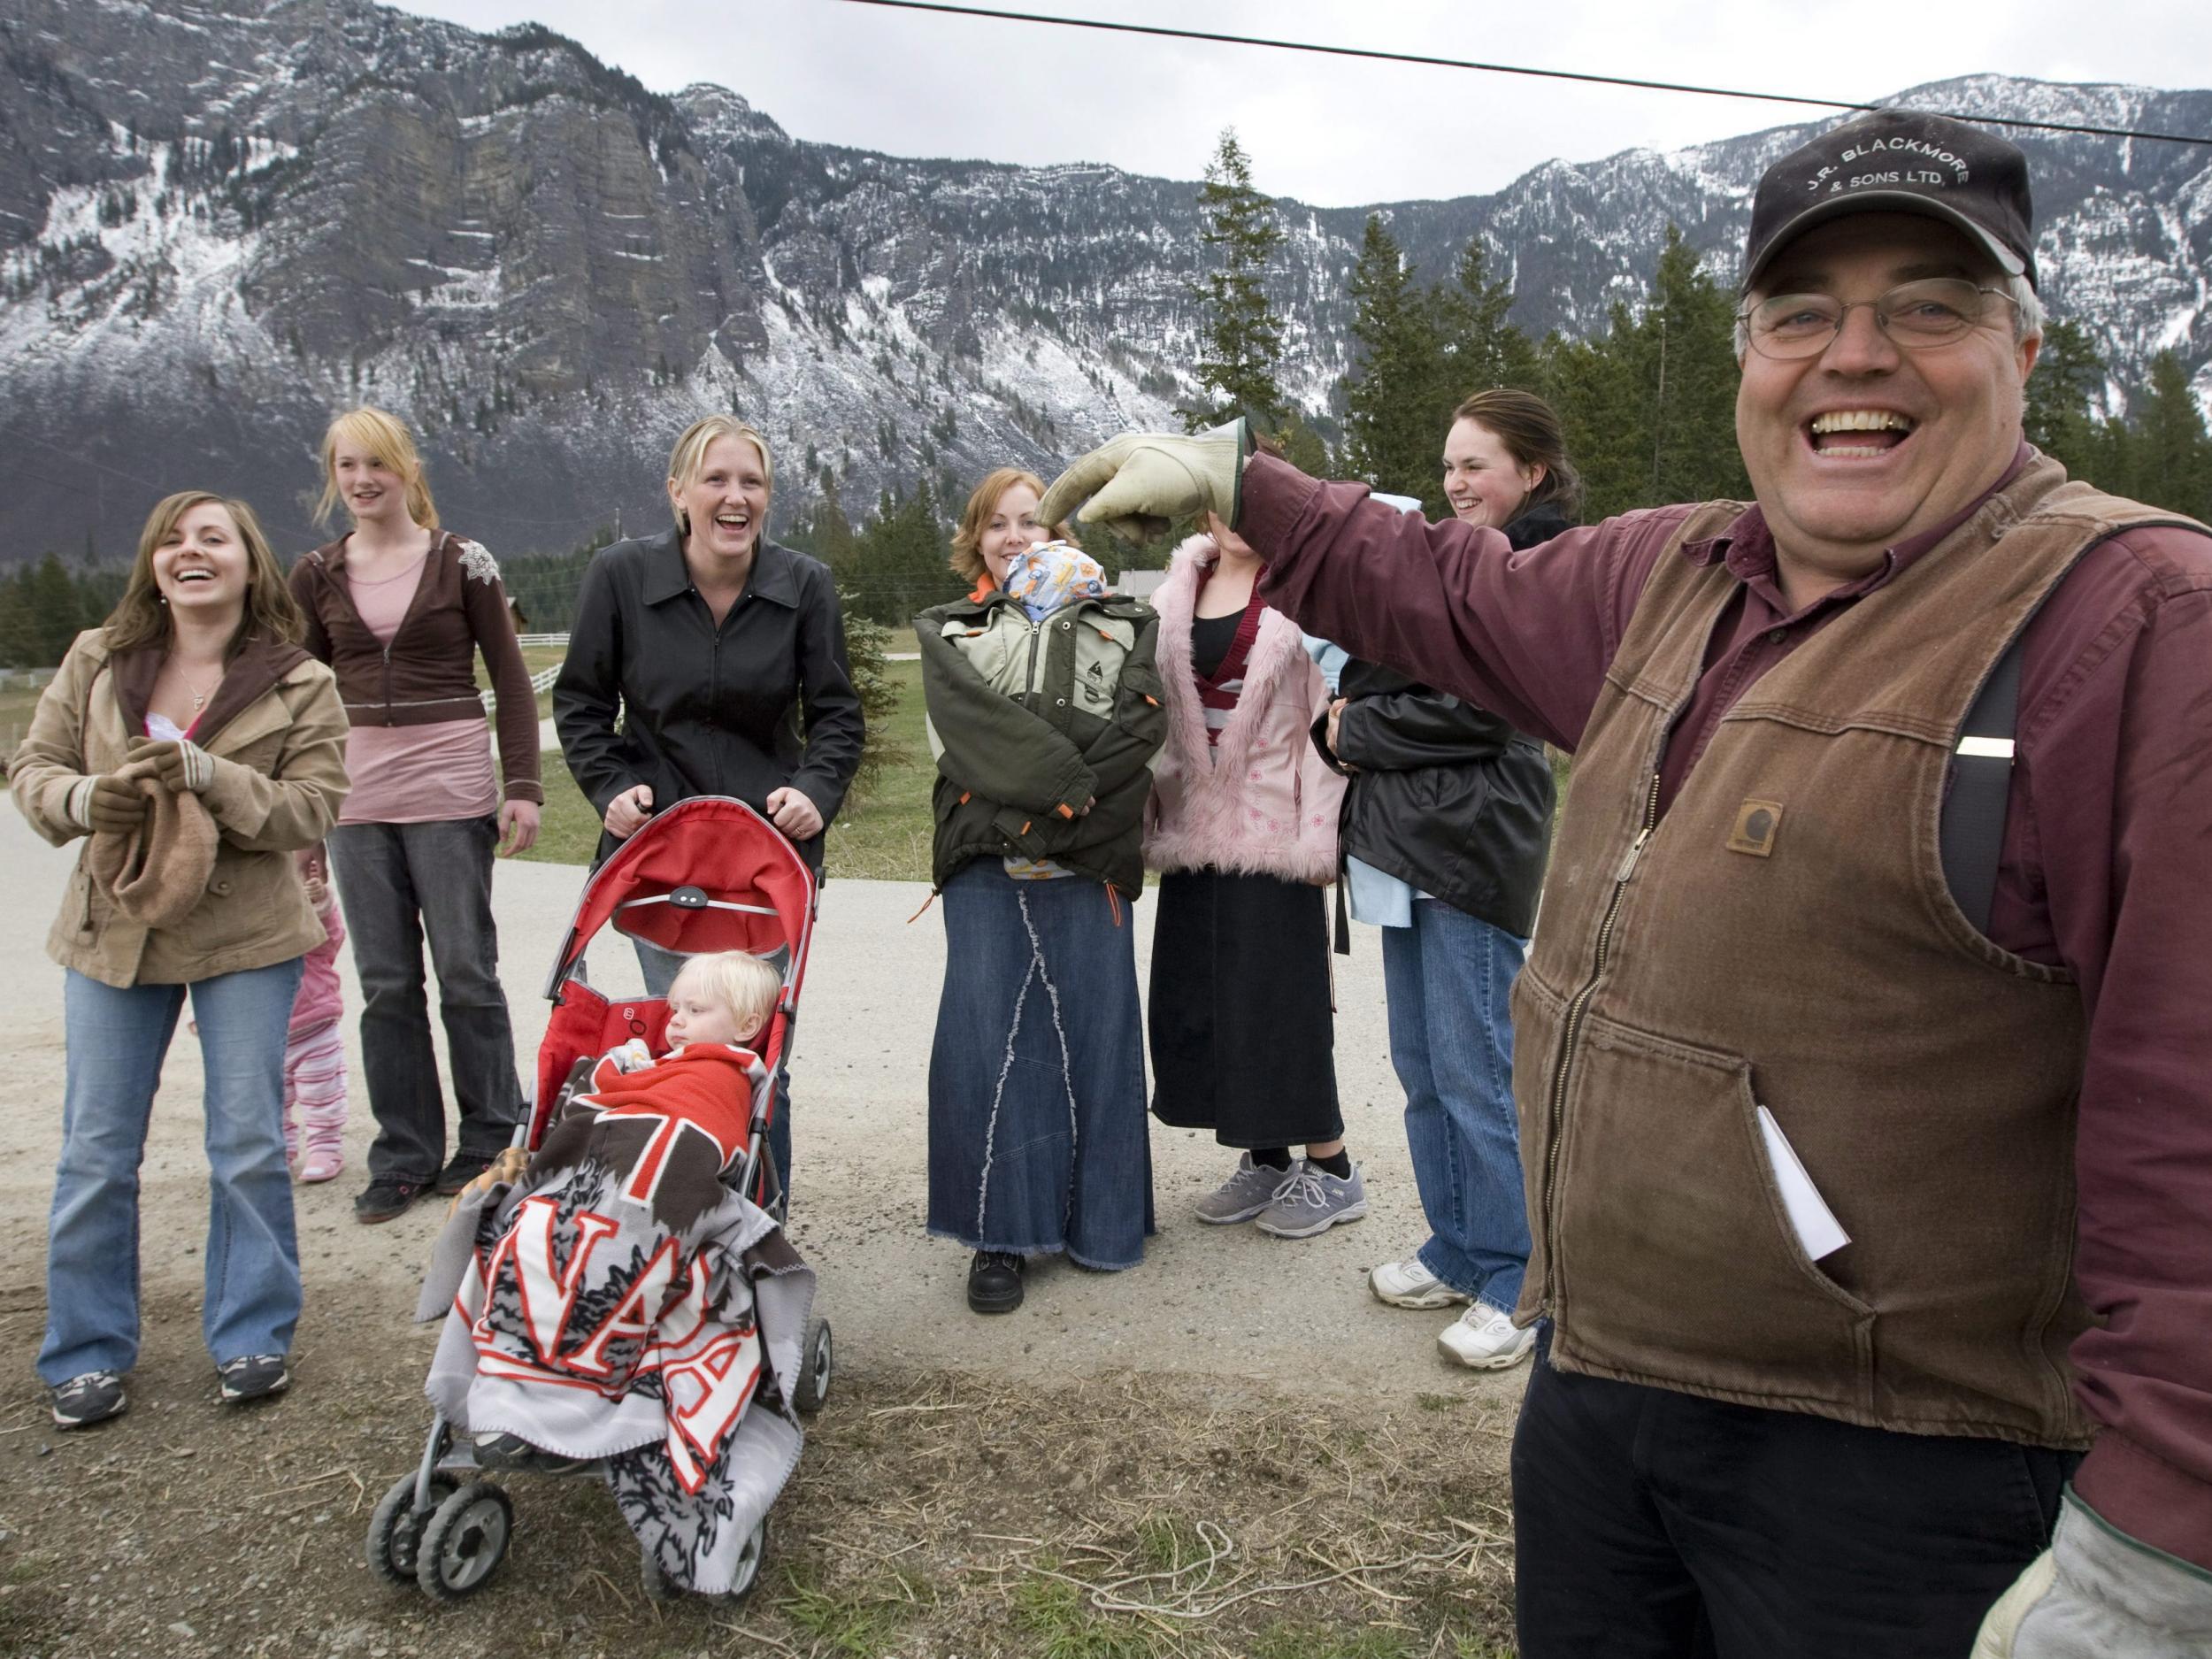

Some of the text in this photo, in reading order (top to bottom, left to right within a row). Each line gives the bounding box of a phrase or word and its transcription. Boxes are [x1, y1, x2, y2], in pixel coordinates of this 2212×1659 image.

[1807, 137, 1970, 190] J.R. BLACKMORE
[1830, 181, 1843, 193] &
[1850, 172, 1900, 188] SONS
